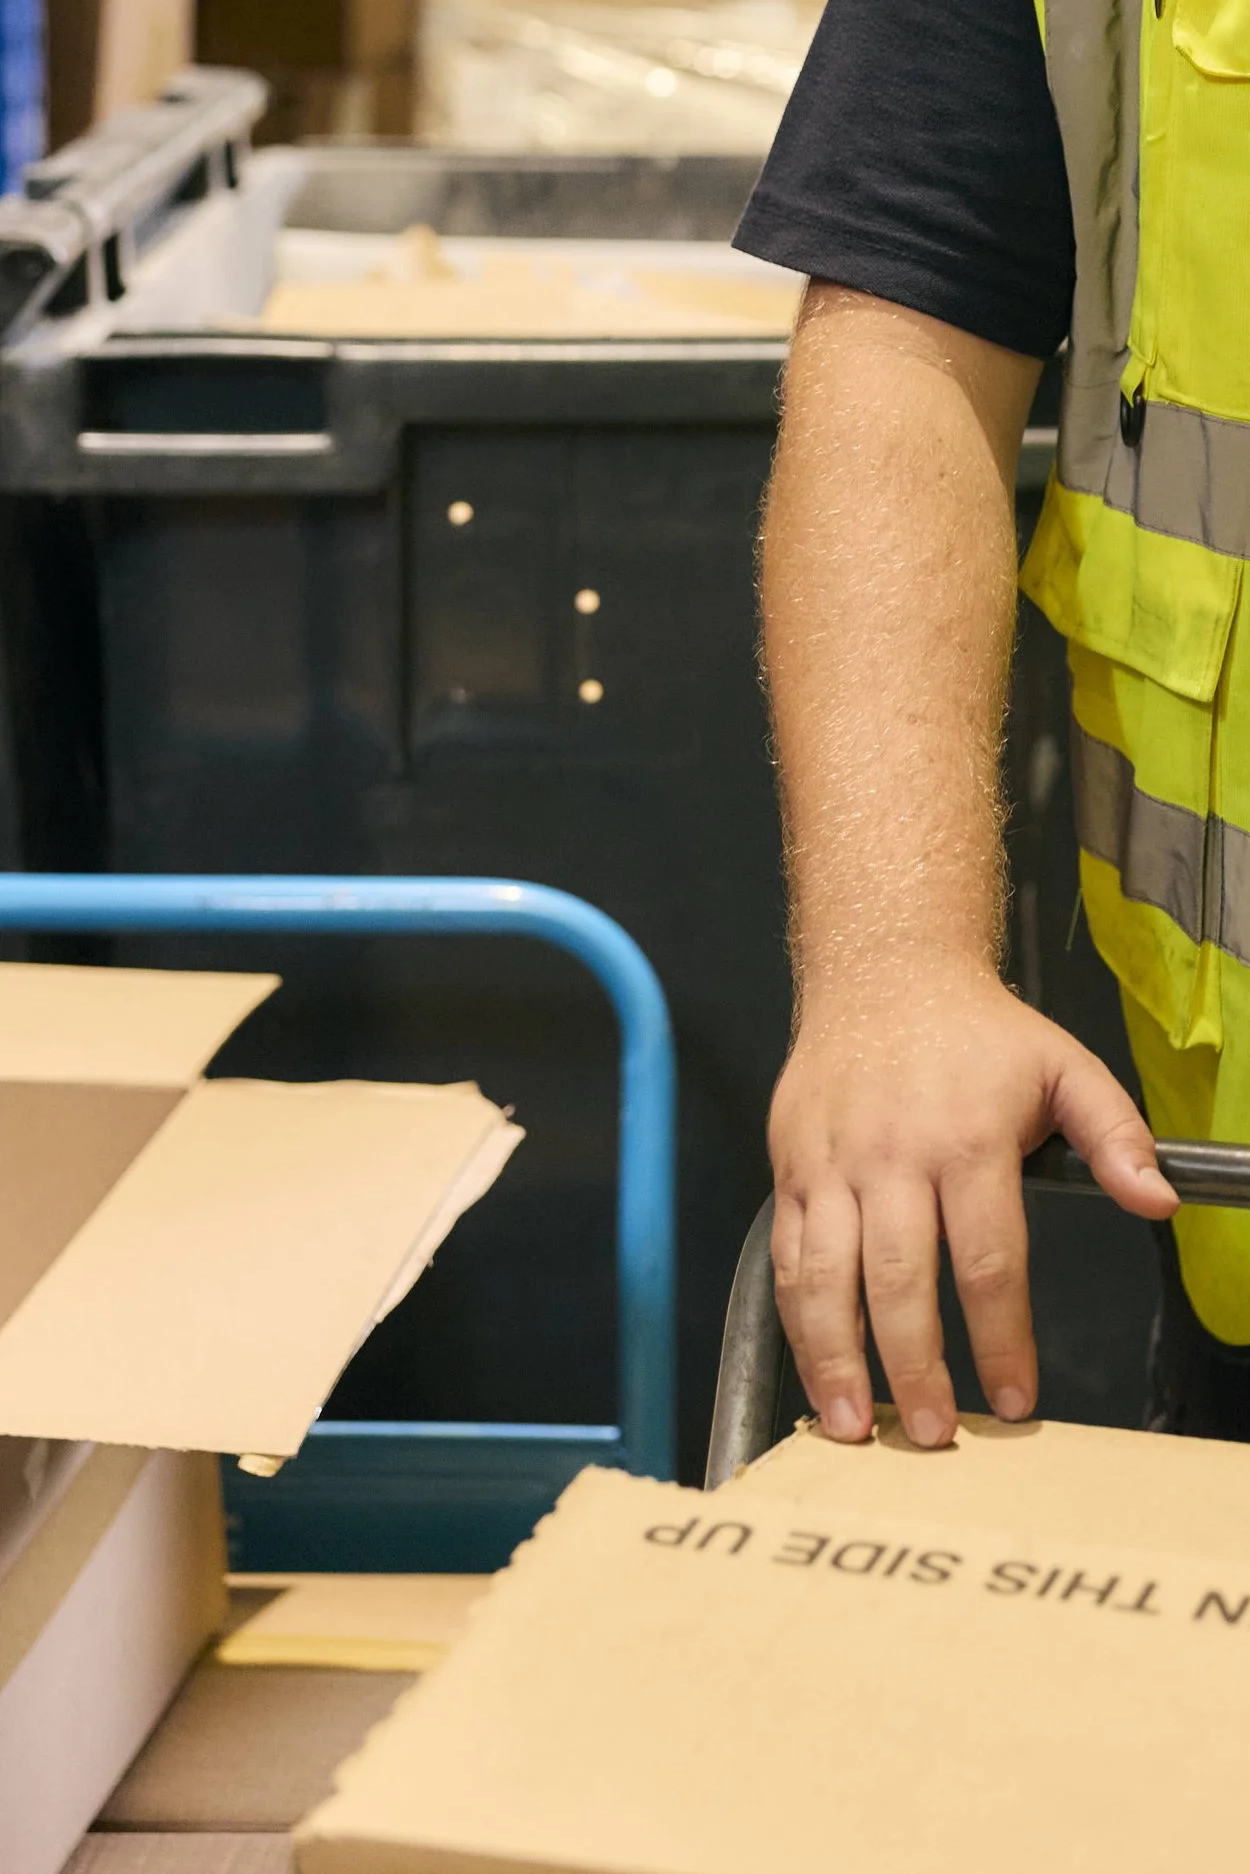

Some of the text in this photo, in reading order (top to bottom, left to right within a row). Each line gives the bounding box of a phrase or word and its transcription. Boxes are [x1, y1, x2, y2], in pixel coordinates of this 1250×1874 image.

[643, 1516, 754, 1556] UP
[771, 1529, 963, 1585] SIDE
[984, 1559, 1161, 1616] THIS
